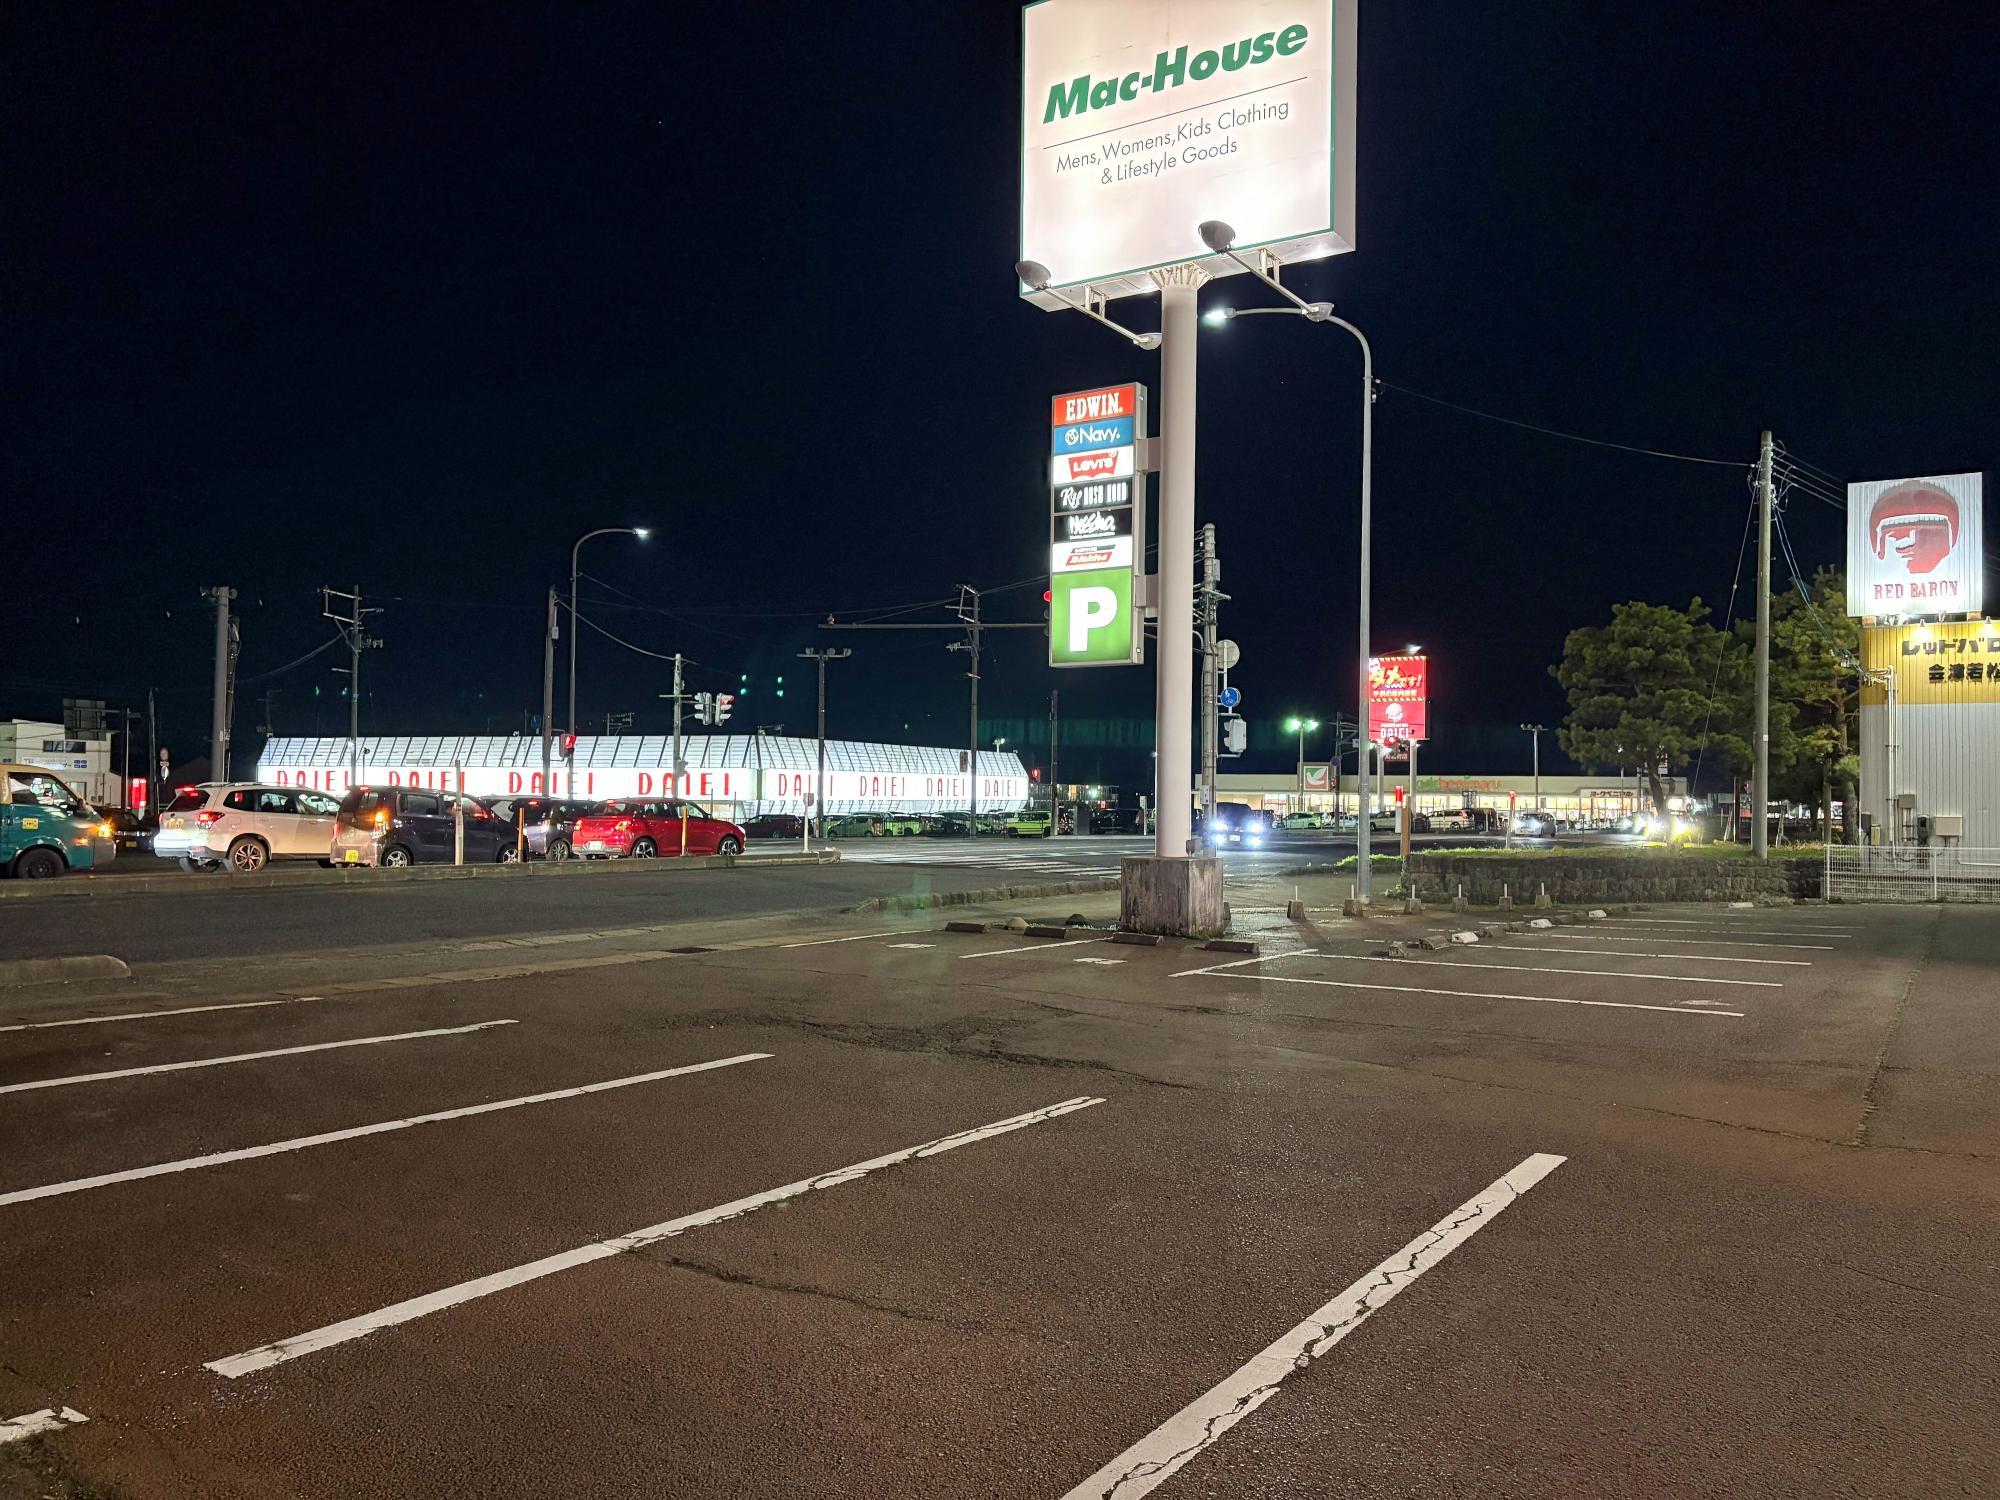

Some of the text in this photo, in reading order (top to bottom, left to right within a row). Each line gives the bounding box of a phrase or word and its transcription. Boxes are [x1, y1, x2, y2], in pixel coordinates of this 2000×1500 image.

[1043, 24, 1309, 124] Mac-House
[1218, 102, 1290, 130] Clothing
[1101, 139, 1238, 184] & Lifestyle Goods
[1874, 580, 1959, 600] RED BARON
[1069, 586, 1118, 652] P
[860, 776, 905, 797] DAIEI
[926, 777, 965, 797] DAIEI
[985, 779, 1017, 797] DAIEI
